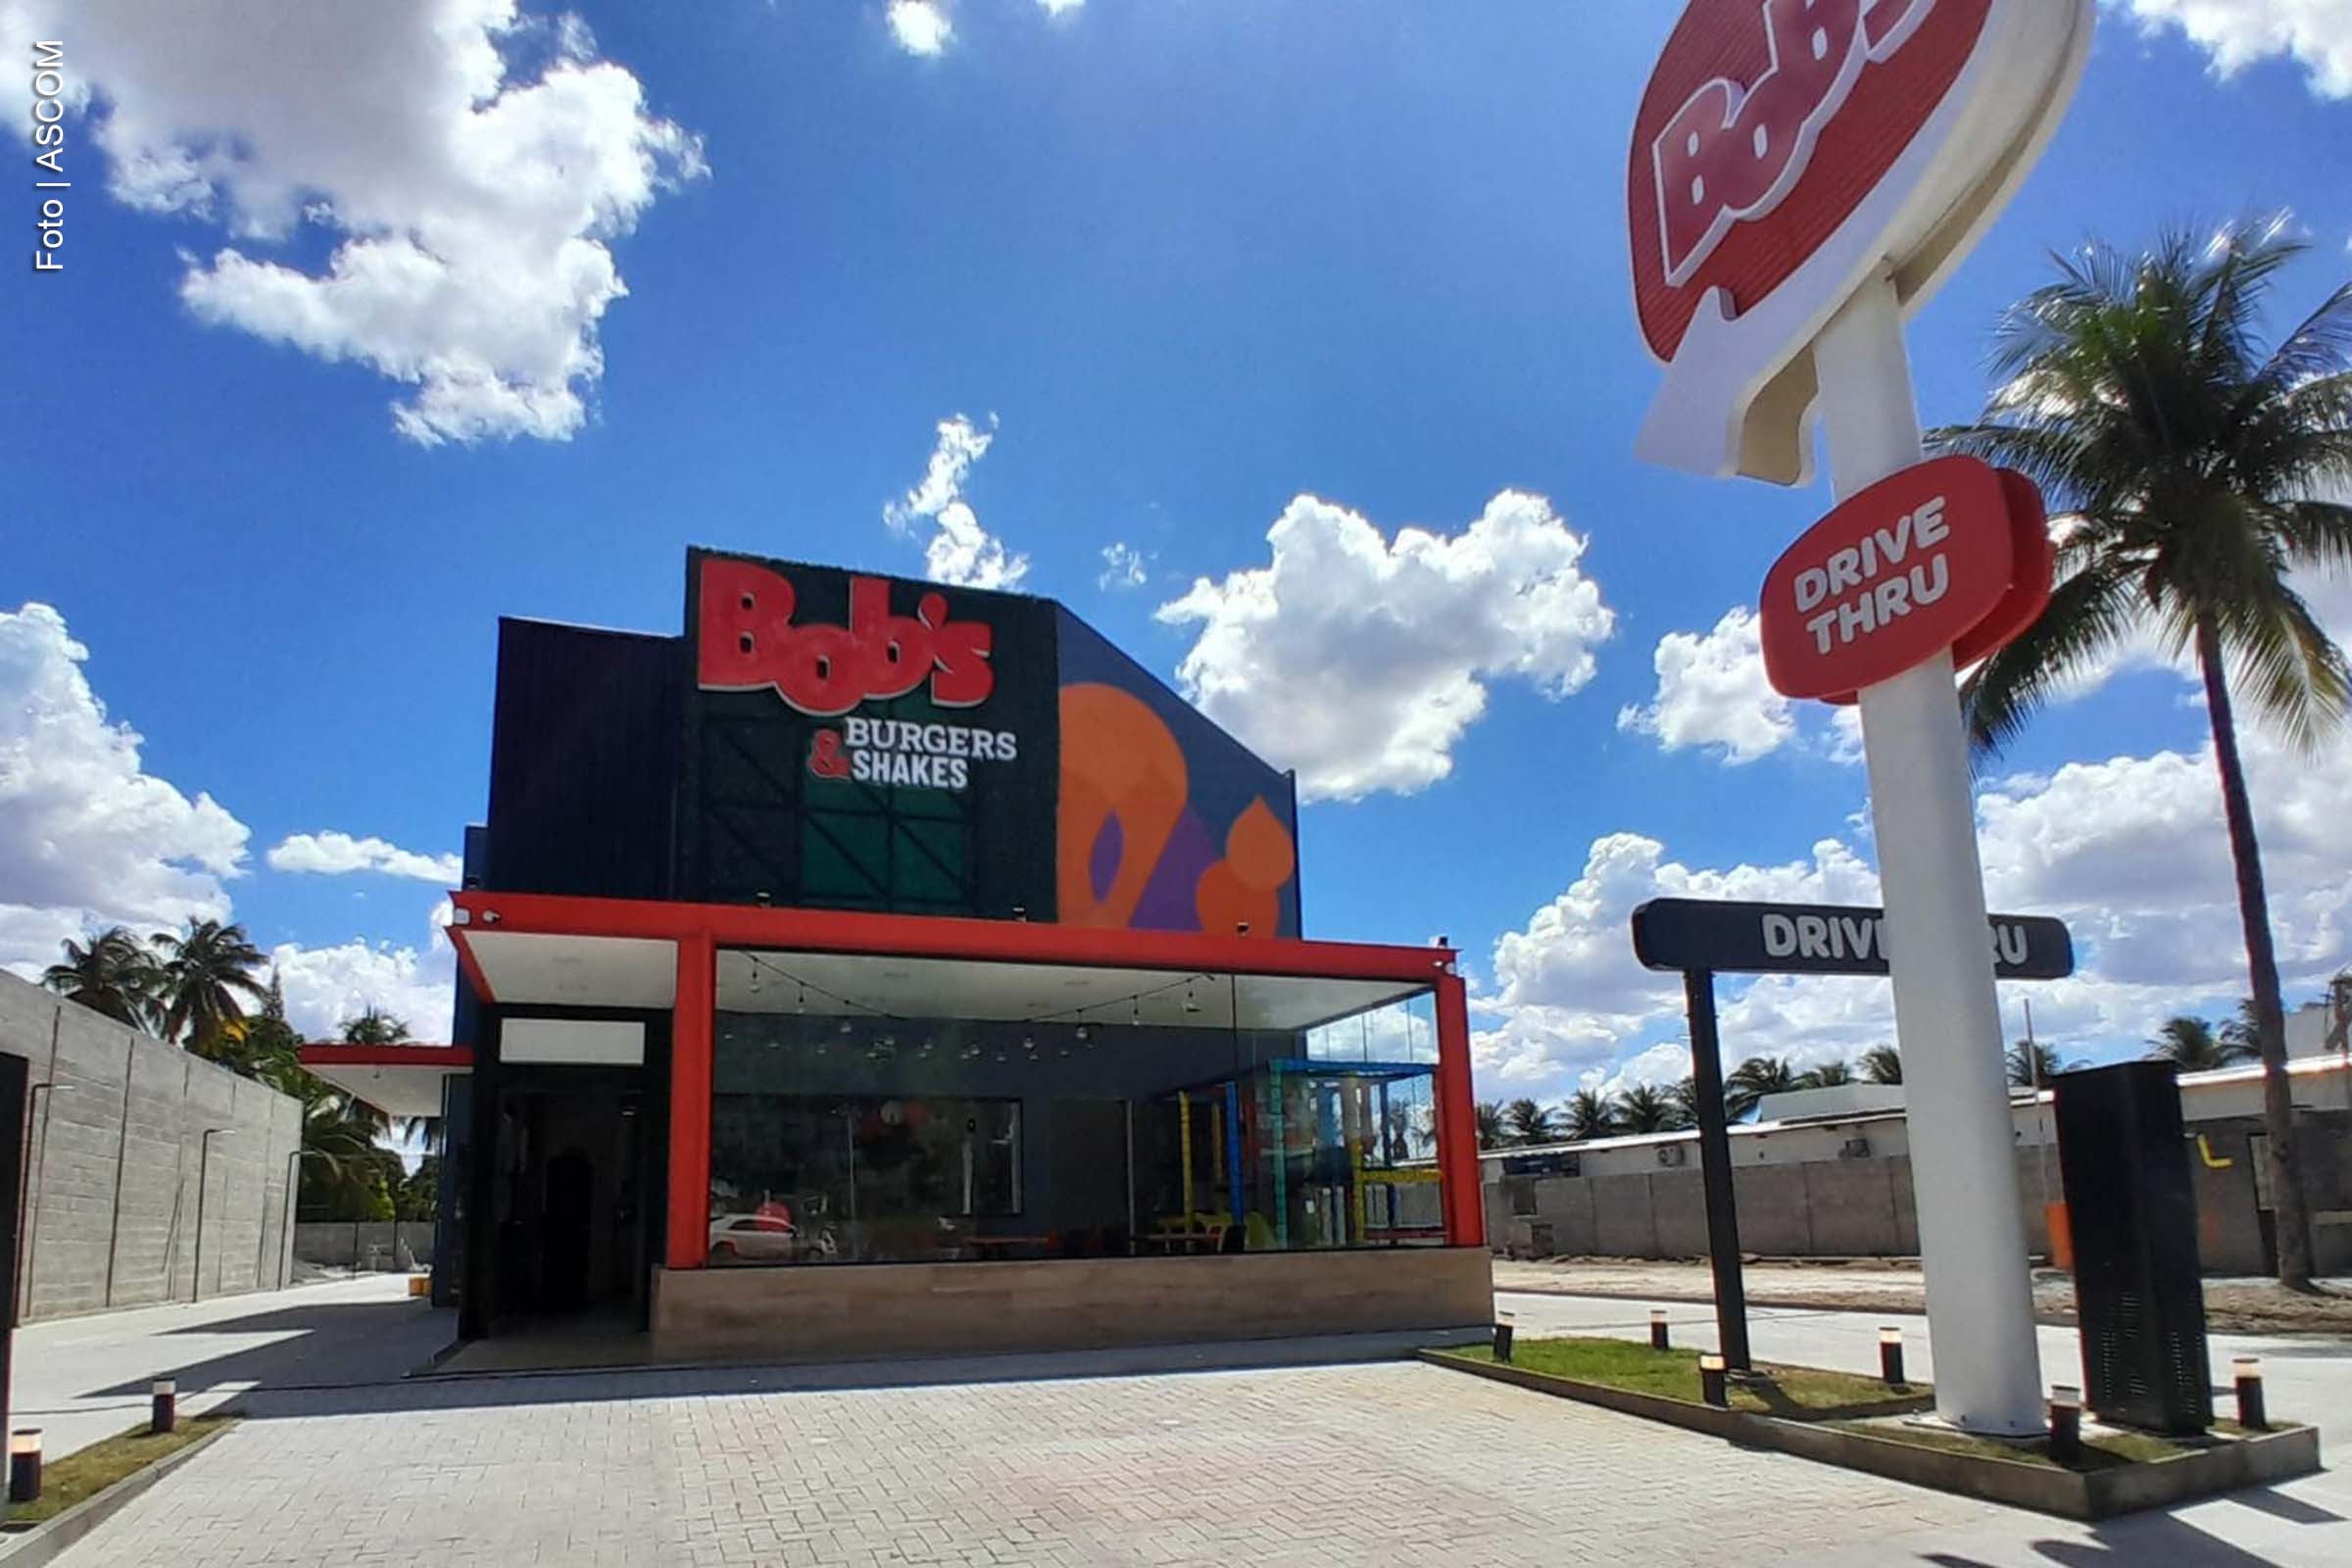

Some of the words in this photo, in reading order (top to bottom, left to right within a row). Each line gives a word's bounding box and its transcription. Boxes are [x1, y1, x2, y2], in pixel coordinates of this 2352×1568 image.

[1793, 496, 1950, 612] DRIVE
[1806, 554, 1949, 655] THRU
[698, 559, 995, 716] Bob's
[808, 729, 851, 779] &
[853, 749, 969, 788] SHAKES
[845, 716, 1017, 761] BURGERS
